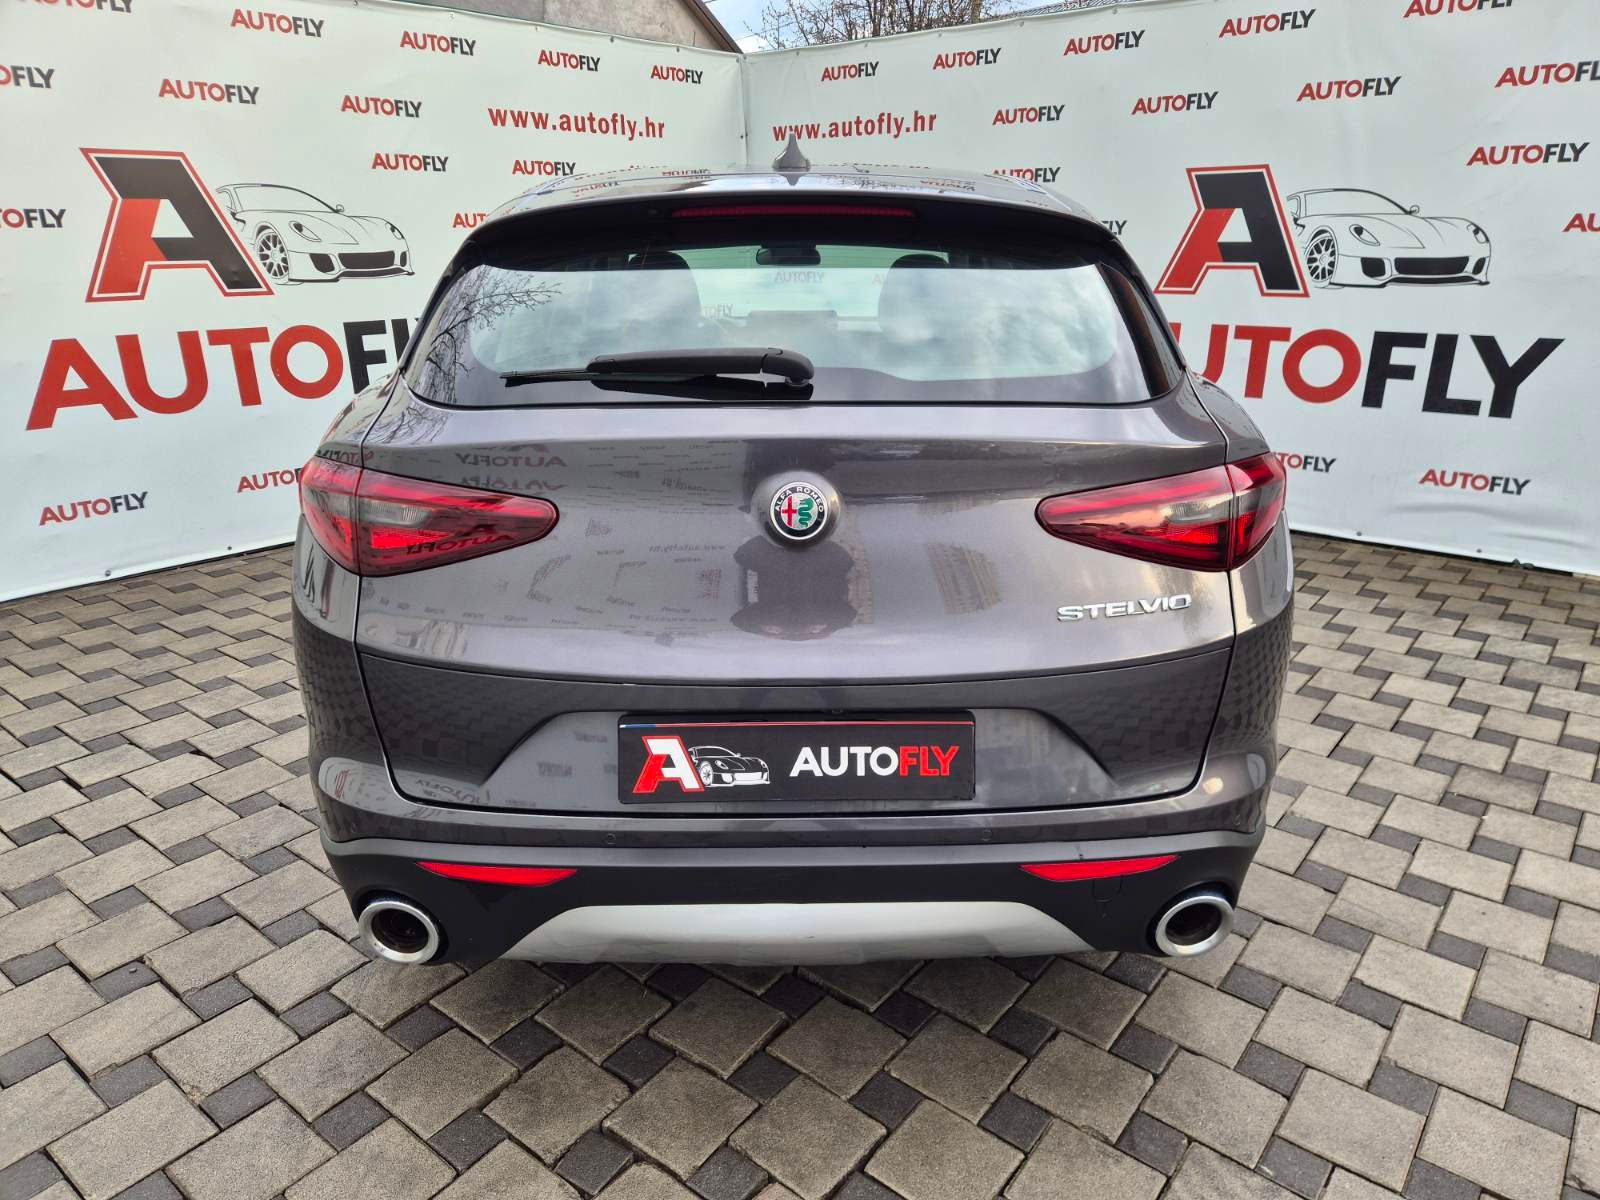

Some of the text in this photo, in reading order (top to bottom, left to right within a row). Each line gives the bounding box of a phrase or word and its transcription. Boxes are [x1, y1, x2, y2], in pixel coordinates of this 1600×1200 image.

[231, 9, 324, 38] AUTOFLY
[1219, 9, 1316, 38] AUTOFLY
[400, 31, 476, 56] AUTOFLY
[1064, 30, 1145, 56] AUTOFLY
[538, 50, 600, 72] AUTOFLY
[933, 48, 1001, 70] AUTOFLY
[651, 65, 703, 84] AUTOFLY
[821, 61, 879, 82] AUTOFLY
[159, 79, 259, 104] AUTOFLY
[1297, 76, 1401, 102] AUTOFLY
[341, 95, 422, 118] AUTOFLY
[992, 104, 1065, 125] AUTOFLY
[1131, 91, 1219, 115] AUTOFLY
[488, 108, 664, 141] www.autofly.hr
[773, 110, 936, 142] www.autofly.hr
[372, 153, 448, 172] AUTOFLY
[1466, 142, 1590, 166] AUTOFLY
[512, 160, 576, 176] AUTOFLY
[0, 208, 66, 228] OFLY
[453, 213, 488, 228] AUT
[1276, 452, 1336, 473] TOFLY
[1419, 469, 1531, 495] AUTOFLY
[40, 491, 148, 526] AUTOFLY
[774, 486, 824, 513] ALFA ROMEO
[1057, 594, 1193, 622] STELVIO
[789, 745, 959, 777] AUTOFLY
